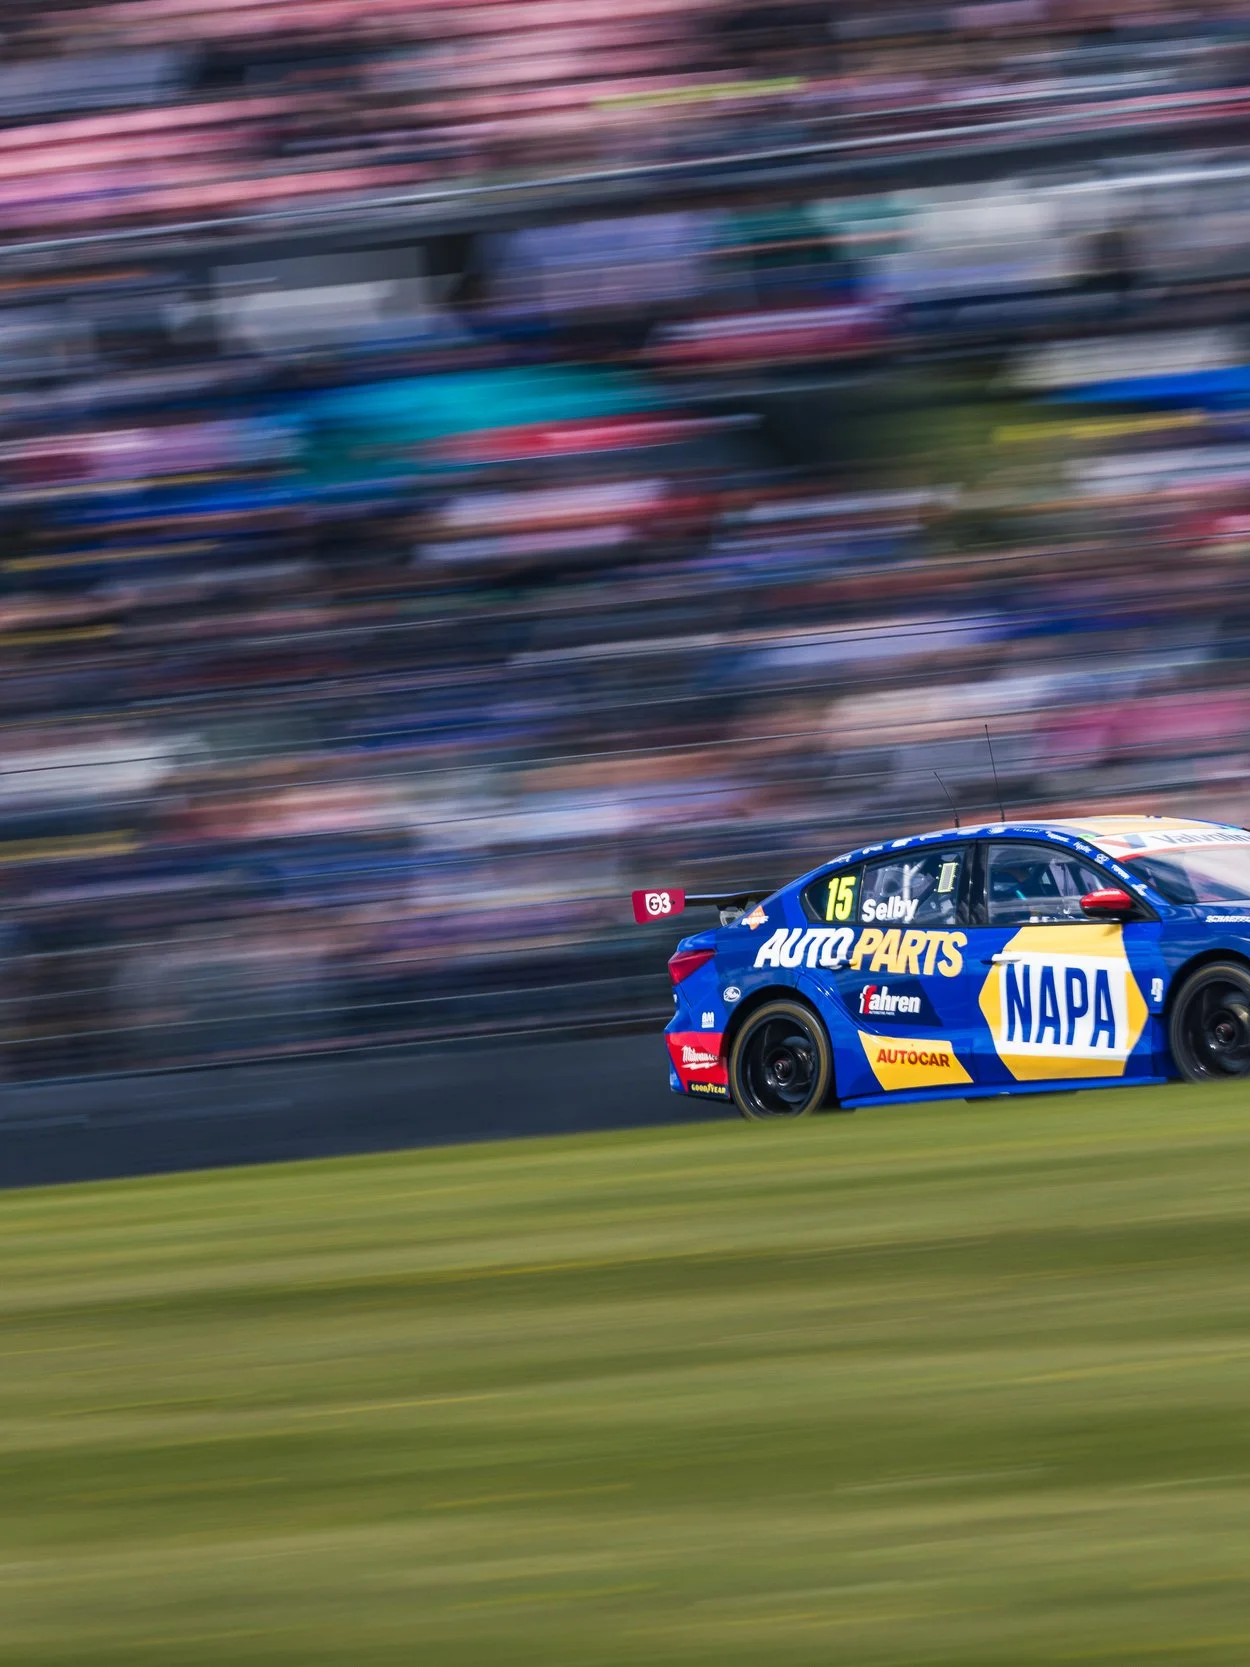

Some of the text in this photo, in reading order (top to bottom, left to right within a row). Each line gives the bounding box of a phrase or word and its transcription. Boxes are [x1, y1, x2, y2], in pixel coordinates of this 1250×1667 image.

[826, 876, 856, 921] 15
[862, 896, 919, 923] Selby
[859, 985, 921, 1014] fahren
[1004, 962, 1116, 1049] NAPA
[876, 1048, 951, 1068] AUTOCAR
[691, 1083, 727, 1095] GOODYEAR
